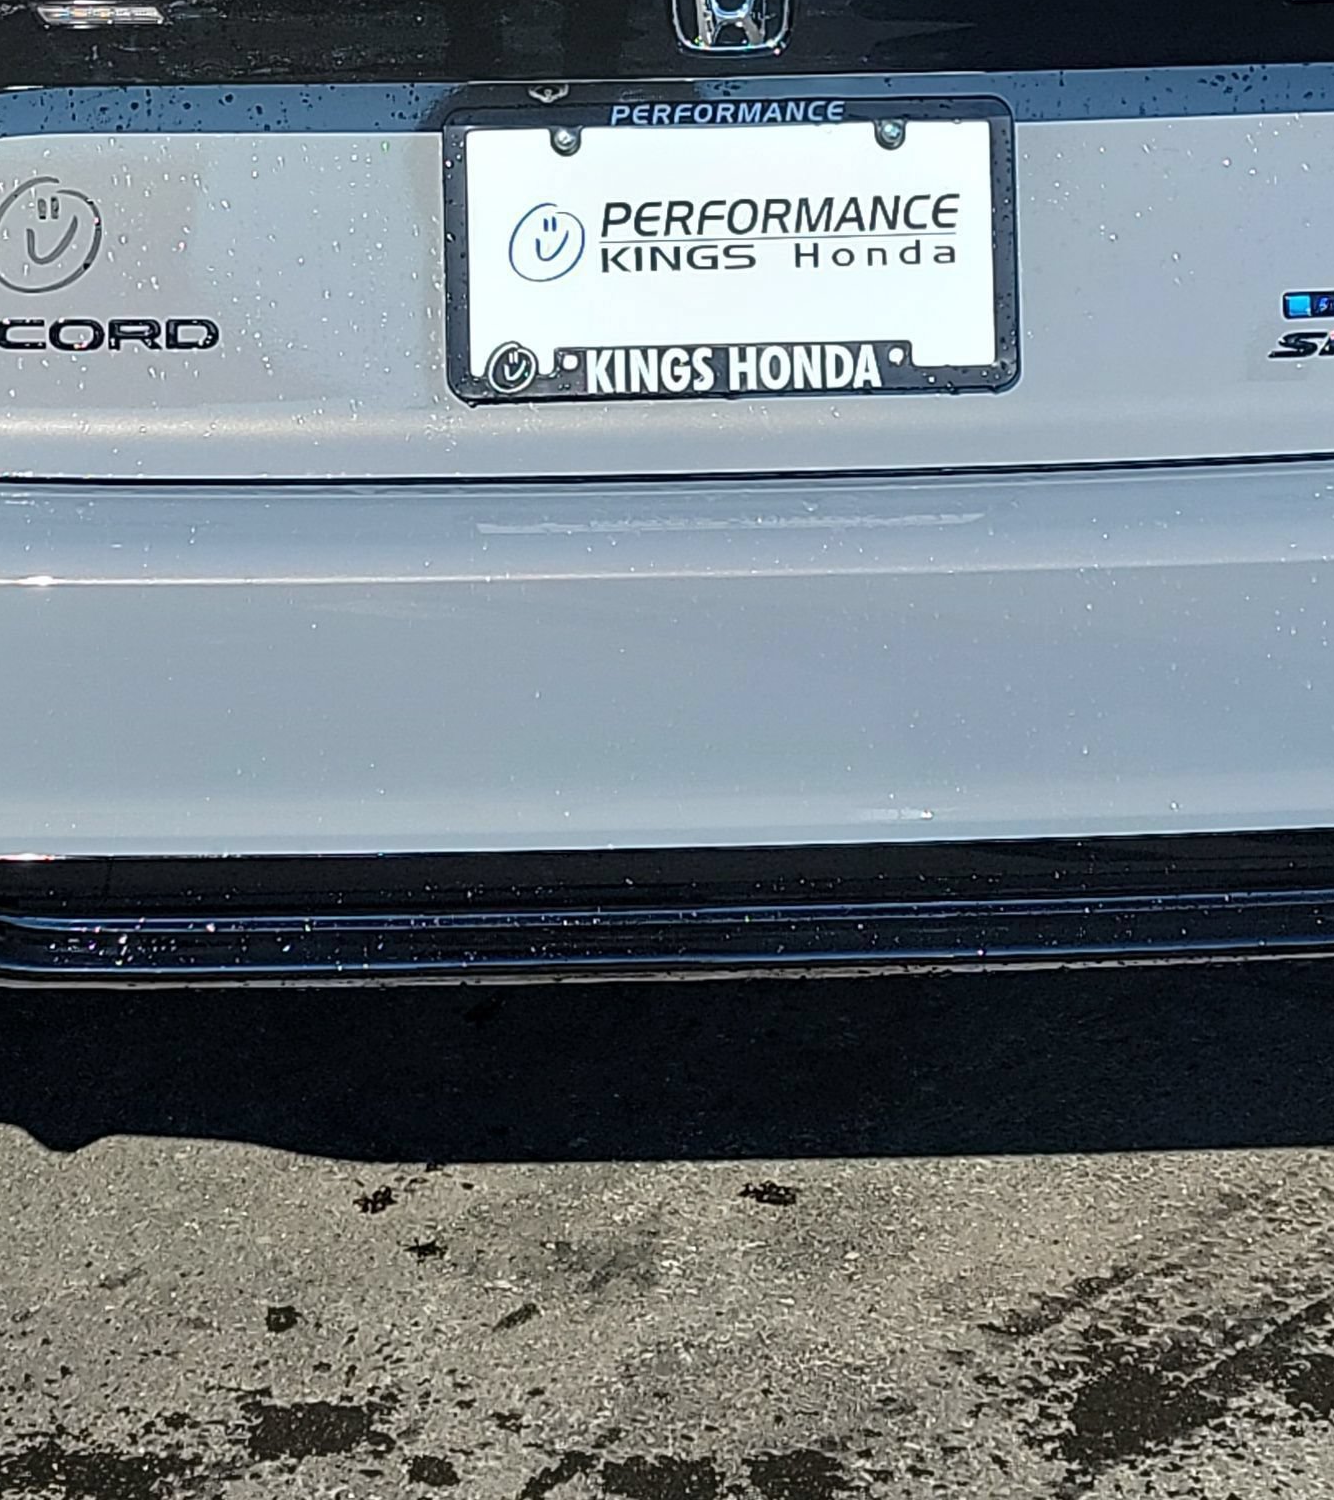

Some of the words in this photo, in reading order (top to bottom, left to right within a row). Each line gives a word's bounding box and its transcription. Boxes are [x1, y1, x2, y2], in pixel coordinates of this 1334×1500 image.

[610, 101, 845, 127] PERFORMANCE
[601, 193, 960, 238] PERFORMANCE
[601, 243, 757, 273] KINGS
[794, 239, 957, 270] Honda
[585, 346, 715, 393] KINGS
[728, 345, 883, 390] HONDA
